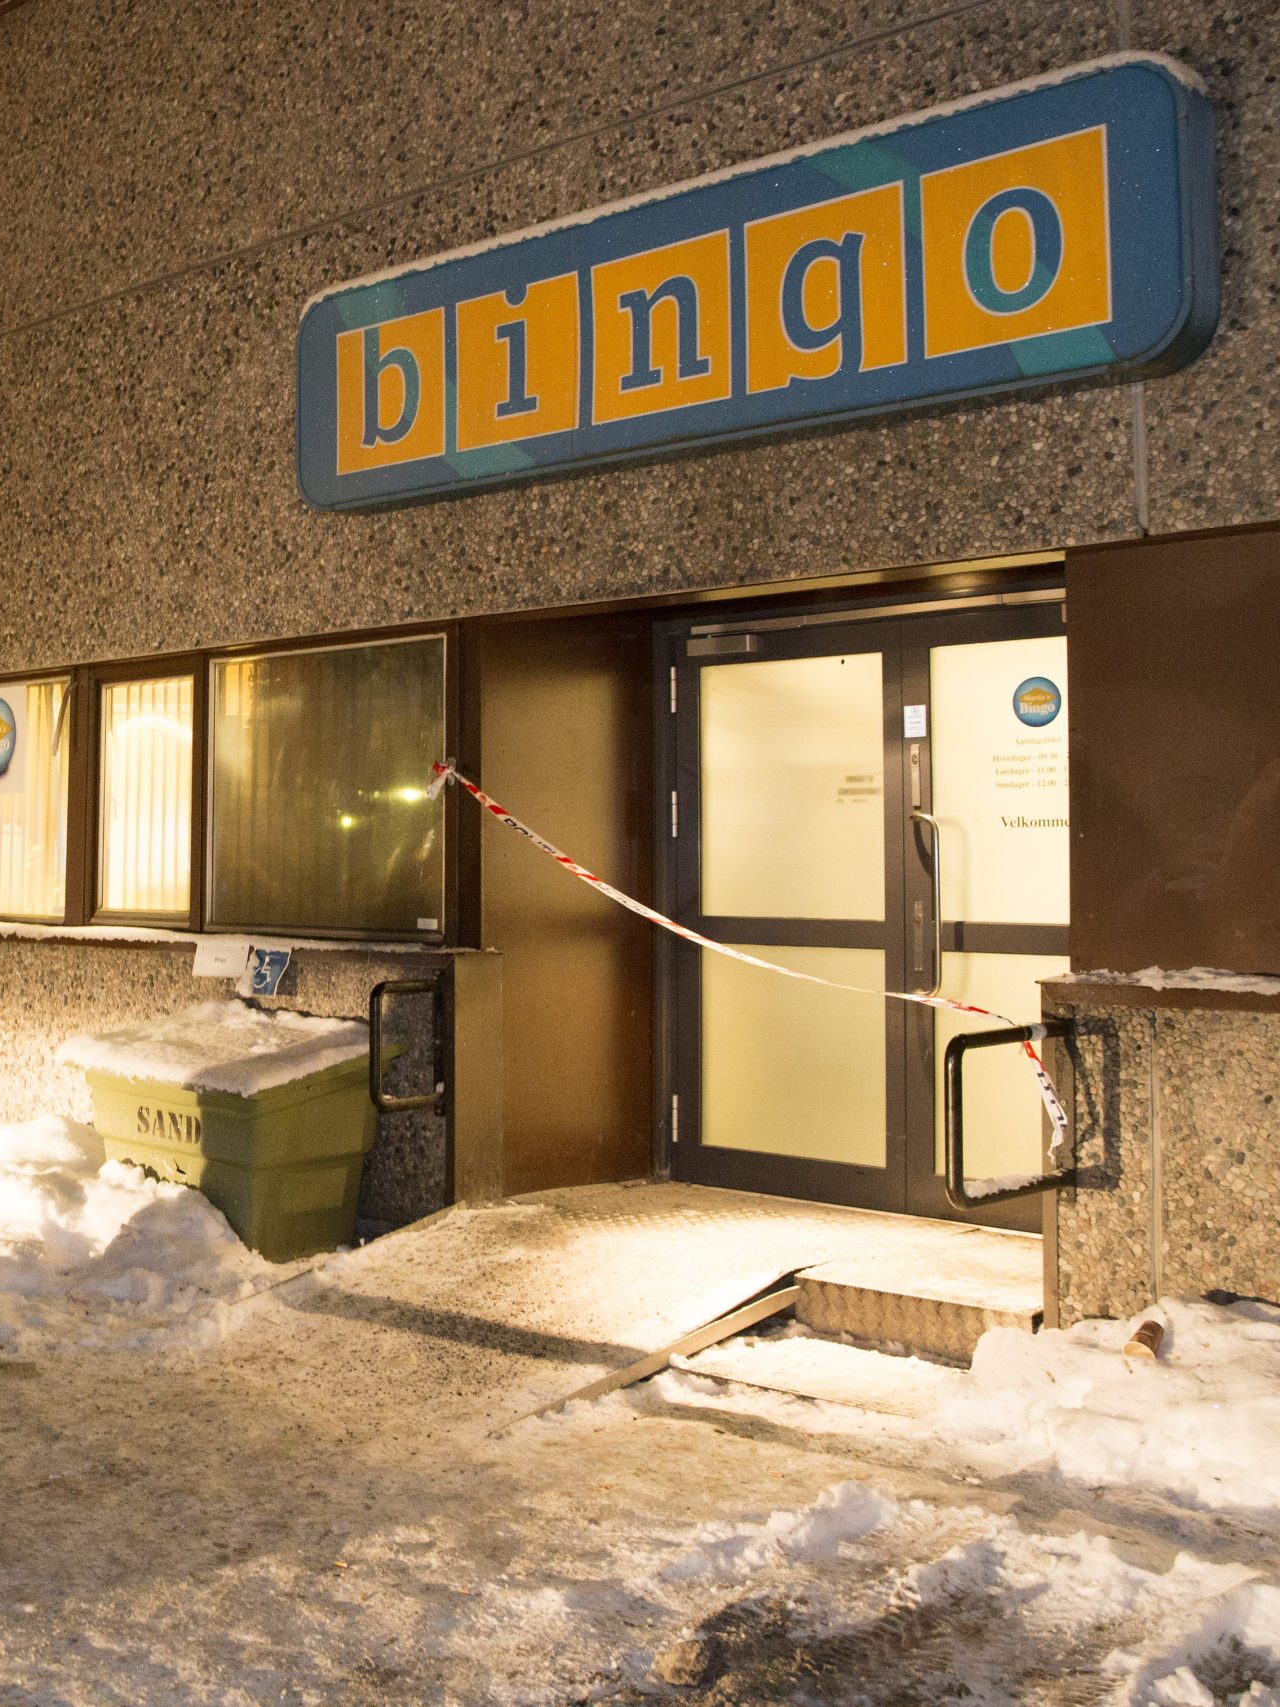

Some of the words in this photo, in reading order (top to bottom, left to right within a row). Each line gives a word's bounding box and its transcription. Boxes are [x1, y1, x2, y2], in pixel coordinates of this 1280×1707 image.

[361, 185, 1064, 450] bingo
[1019, 702, 1056, 716] Bingo
[136, 1105, 203, 1146] SAND
